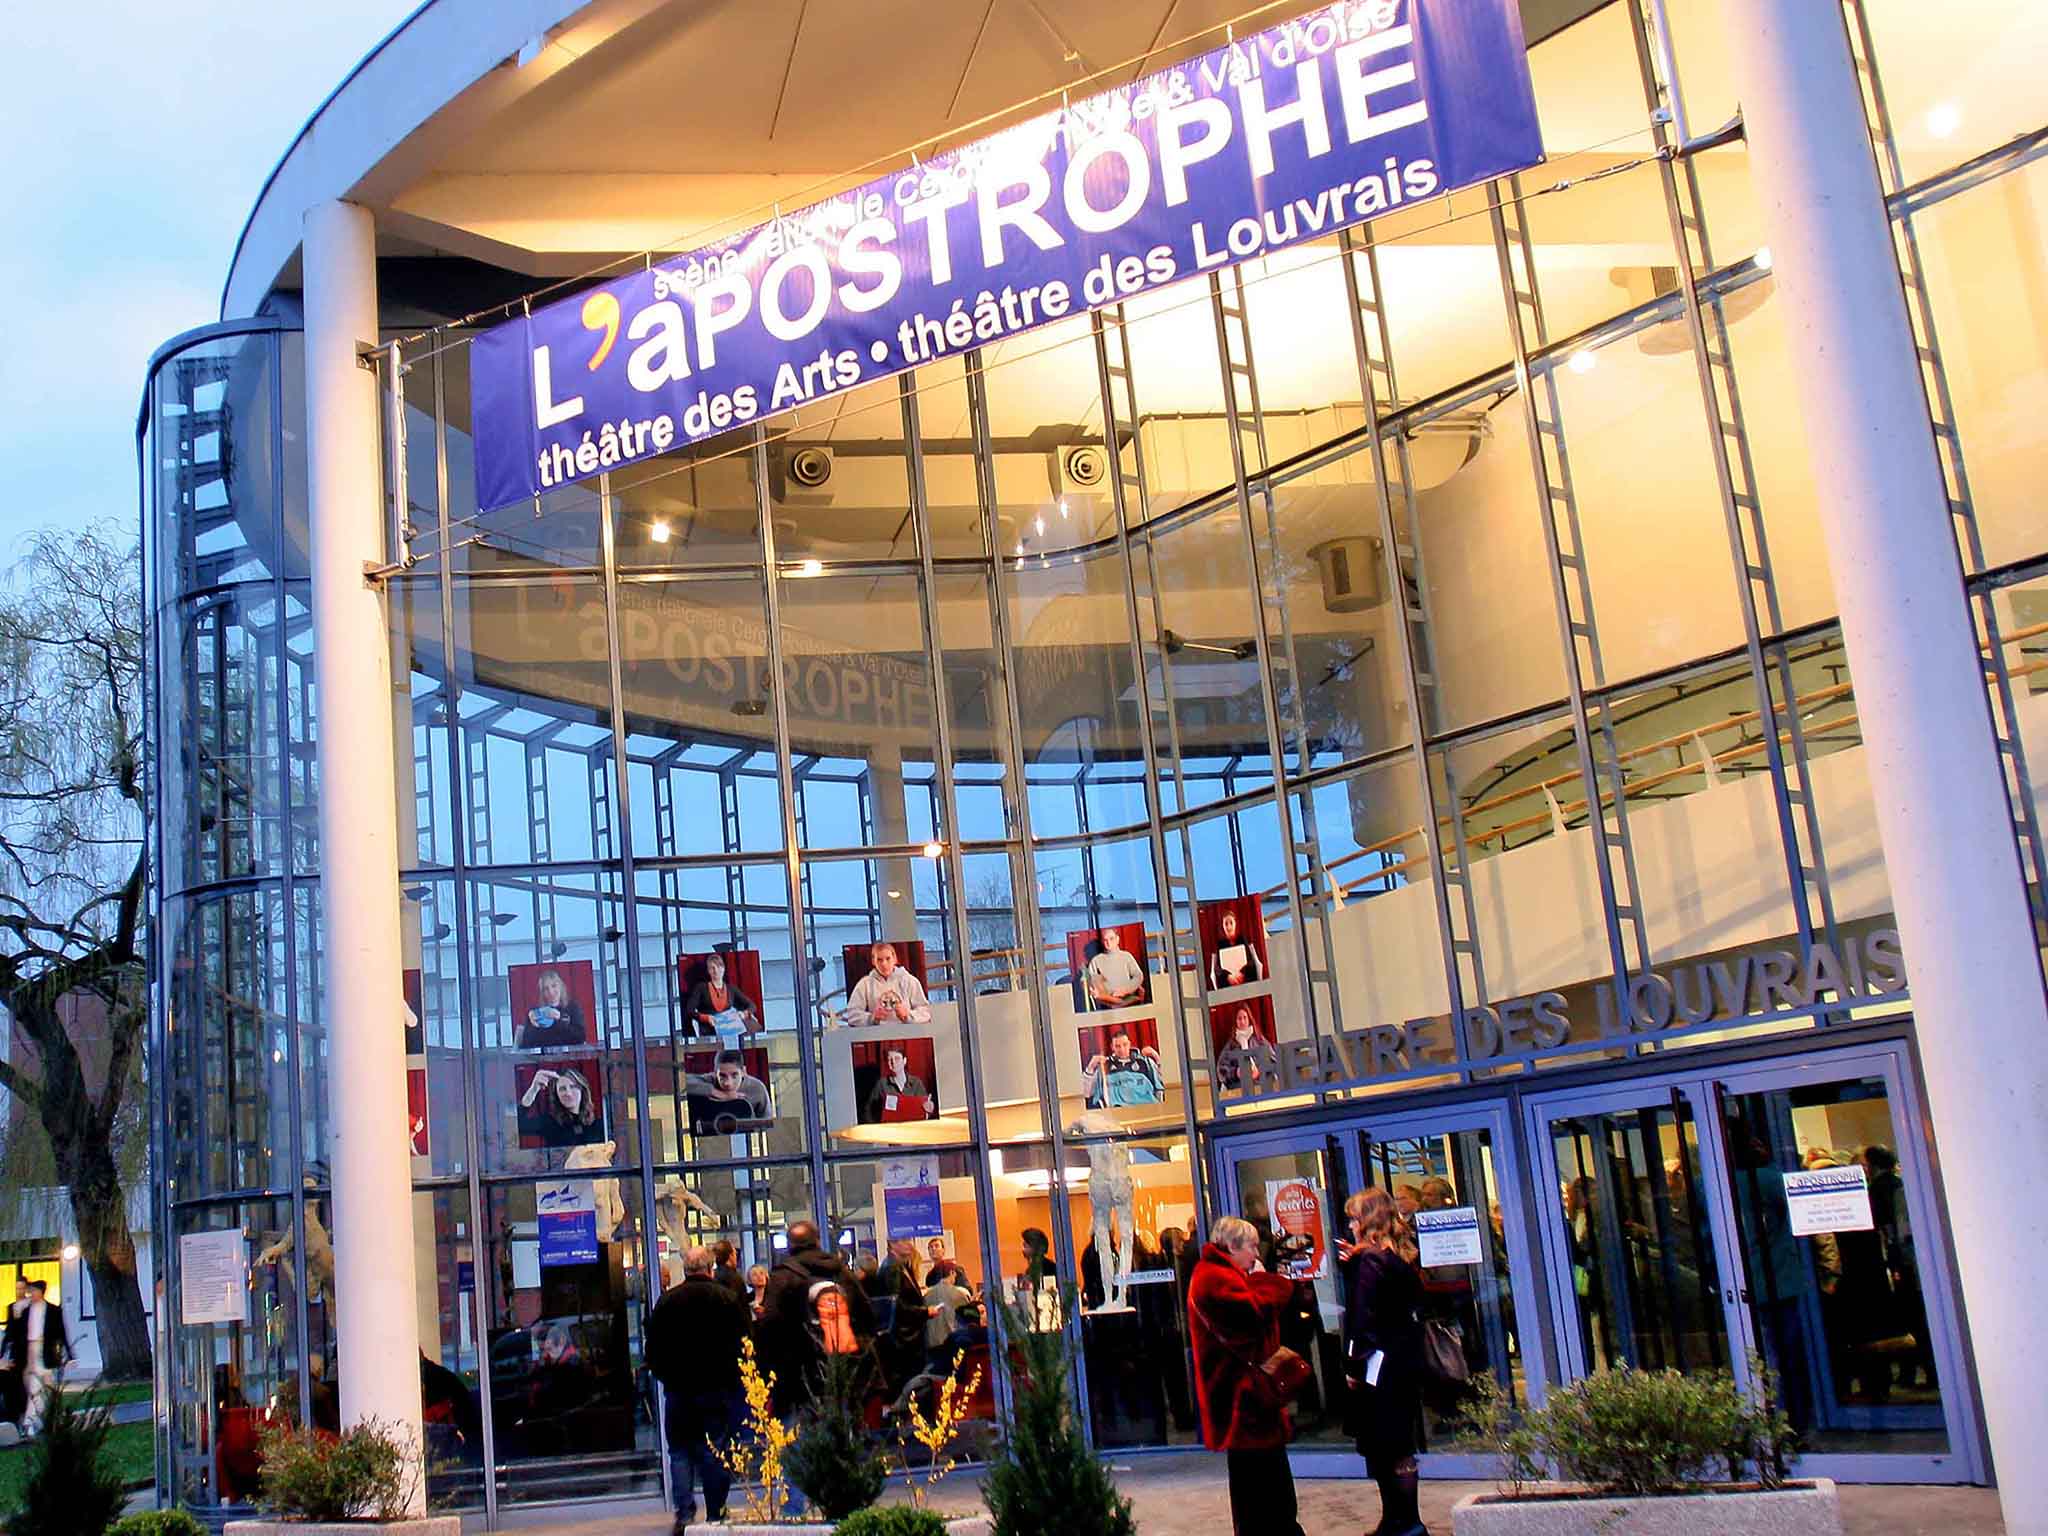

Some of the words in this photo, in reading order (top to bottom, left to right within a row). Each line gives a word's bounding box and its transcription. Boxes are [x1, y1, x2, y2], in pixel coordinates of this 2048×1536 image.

[1201, 38, 1261, 93] Val
[537, 416, 675, 488] théâtre
[683, 381, 759, 437] des
[769, 349, 863, 410] Arts
[897, 279, 1069, 364] théâtre
[1083, 243, 1177, 305] des
[1193, 155, 1439, 270] Louvrais
[1464, 990, 1572, 1060] DES
[1594, 928, 1907, 1041] LOUVRAIS
